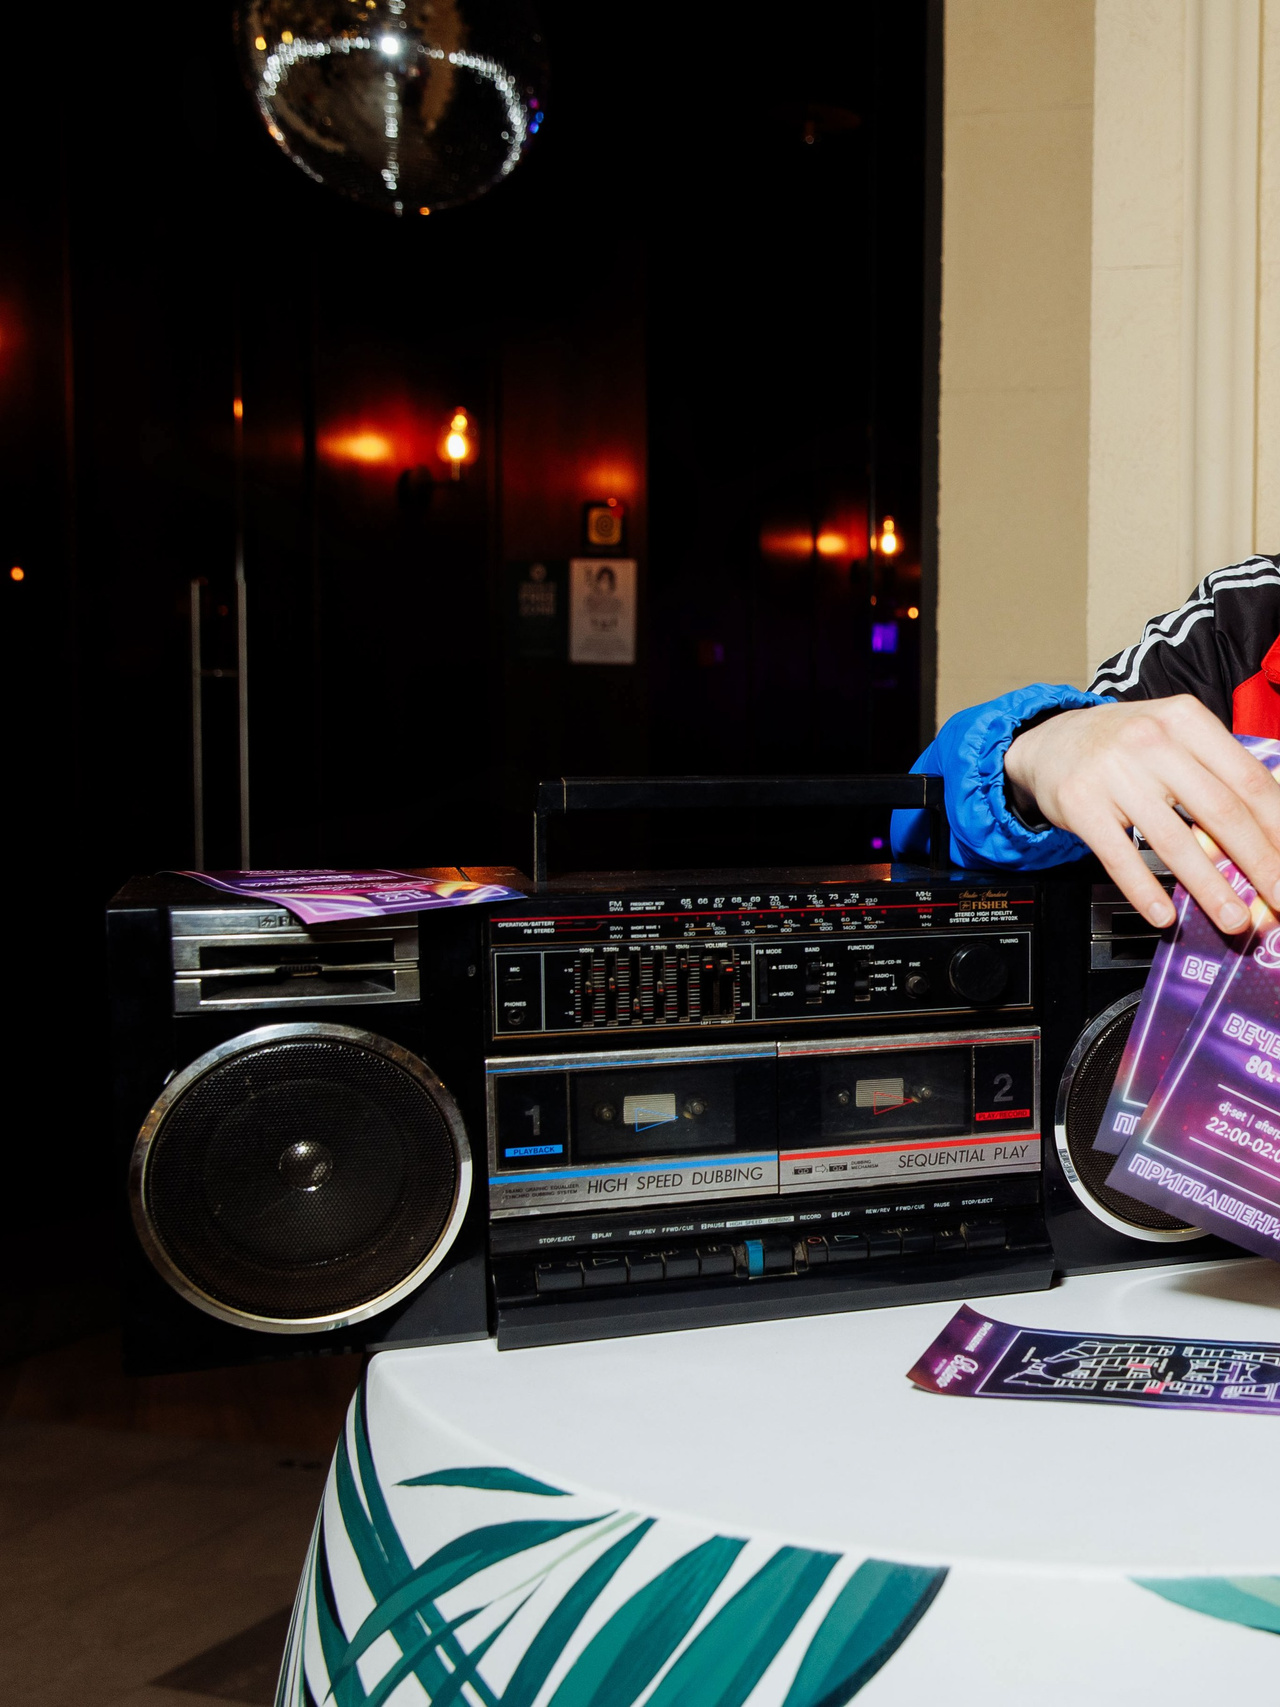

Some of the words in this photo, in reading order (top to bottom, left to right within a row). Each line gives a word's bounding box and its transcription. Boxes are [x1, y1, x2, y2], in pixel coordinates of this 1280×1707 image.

[972, 900, 1008, 910] FISHER
[992, 1073, 1014, 1102] 2
[979, 1109, 1028, 1120] PLAY/RECORD
[1218, 1101, 1247, 1122] dj-set
[524, 1104, 541, 1136] 1
[512, 1146, 556, 1156] PLAYBACK
[897, 1149, 986, 1168] SEQUENTIAL
[993, 1144, 1029, 1160] PLAY
[587, 1178, 628, 1194] HIGH
[636, 1173, 683, 1191] SPEED
[692, 1166, 764, 1186] DUBBING
[961, 1197, 994, 1206] STOP/EJECT
[865, 1206, 890, 1215] REW/REV
[628, 1228, 657, 1236] REW/REV
[538, 1235, 576, 1244] STOP/EJECT
